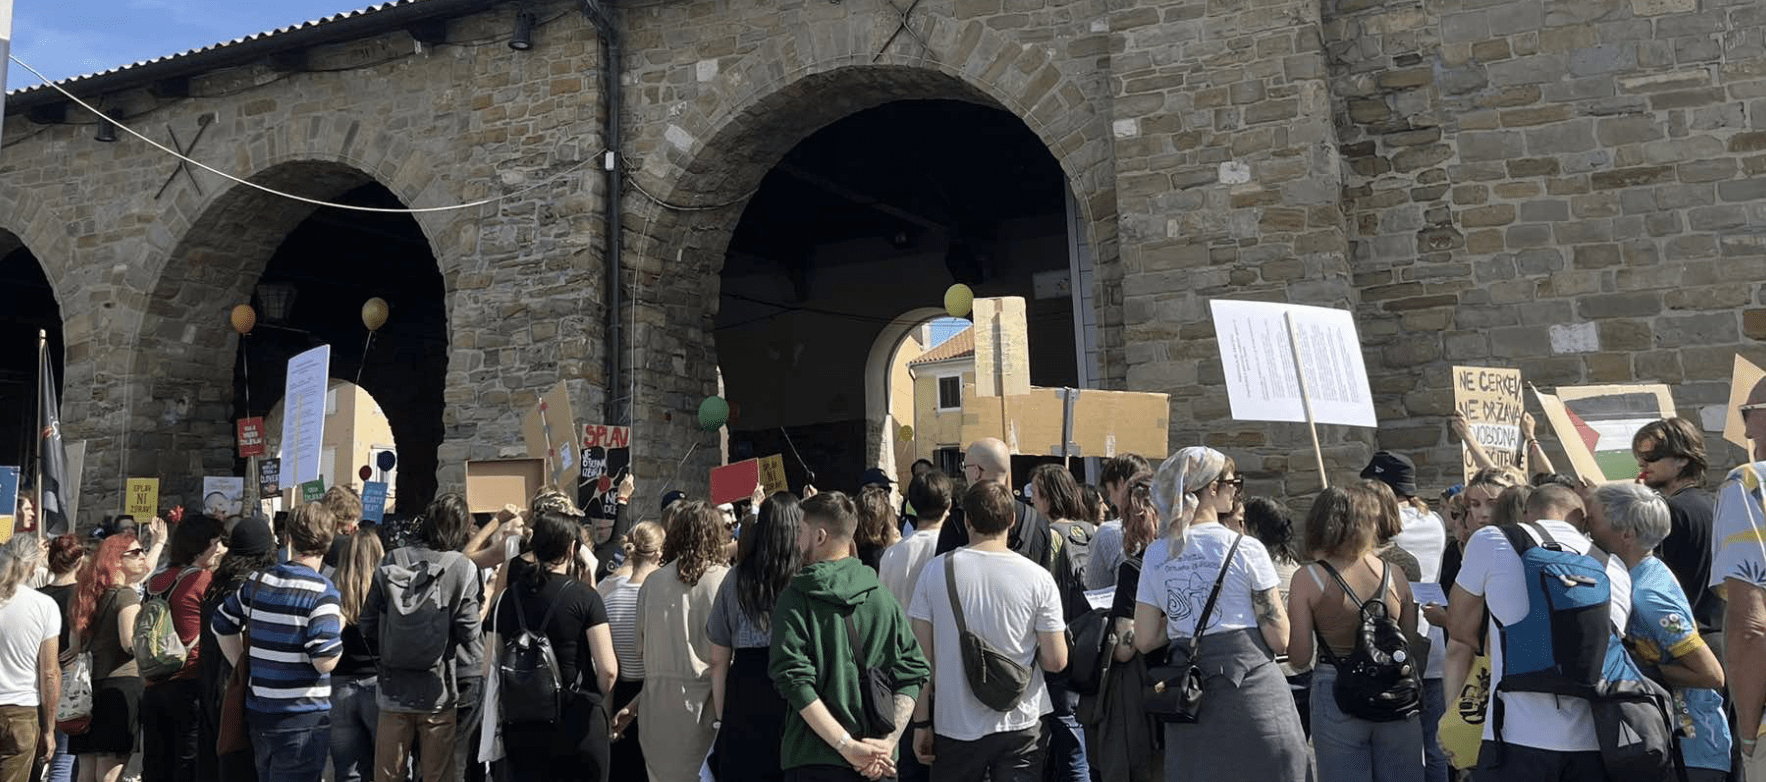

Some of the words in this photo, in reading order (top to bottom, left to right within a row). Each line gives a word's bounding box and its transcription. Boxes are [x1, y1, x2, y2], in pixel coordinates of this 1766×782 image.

[1459, 371, 1475, 391] NE
[1459, 399, 1479, 421] NE
[584, 425, 629, 448] SPLAV
[1468, 424, 1518, 447] VOBODNA
